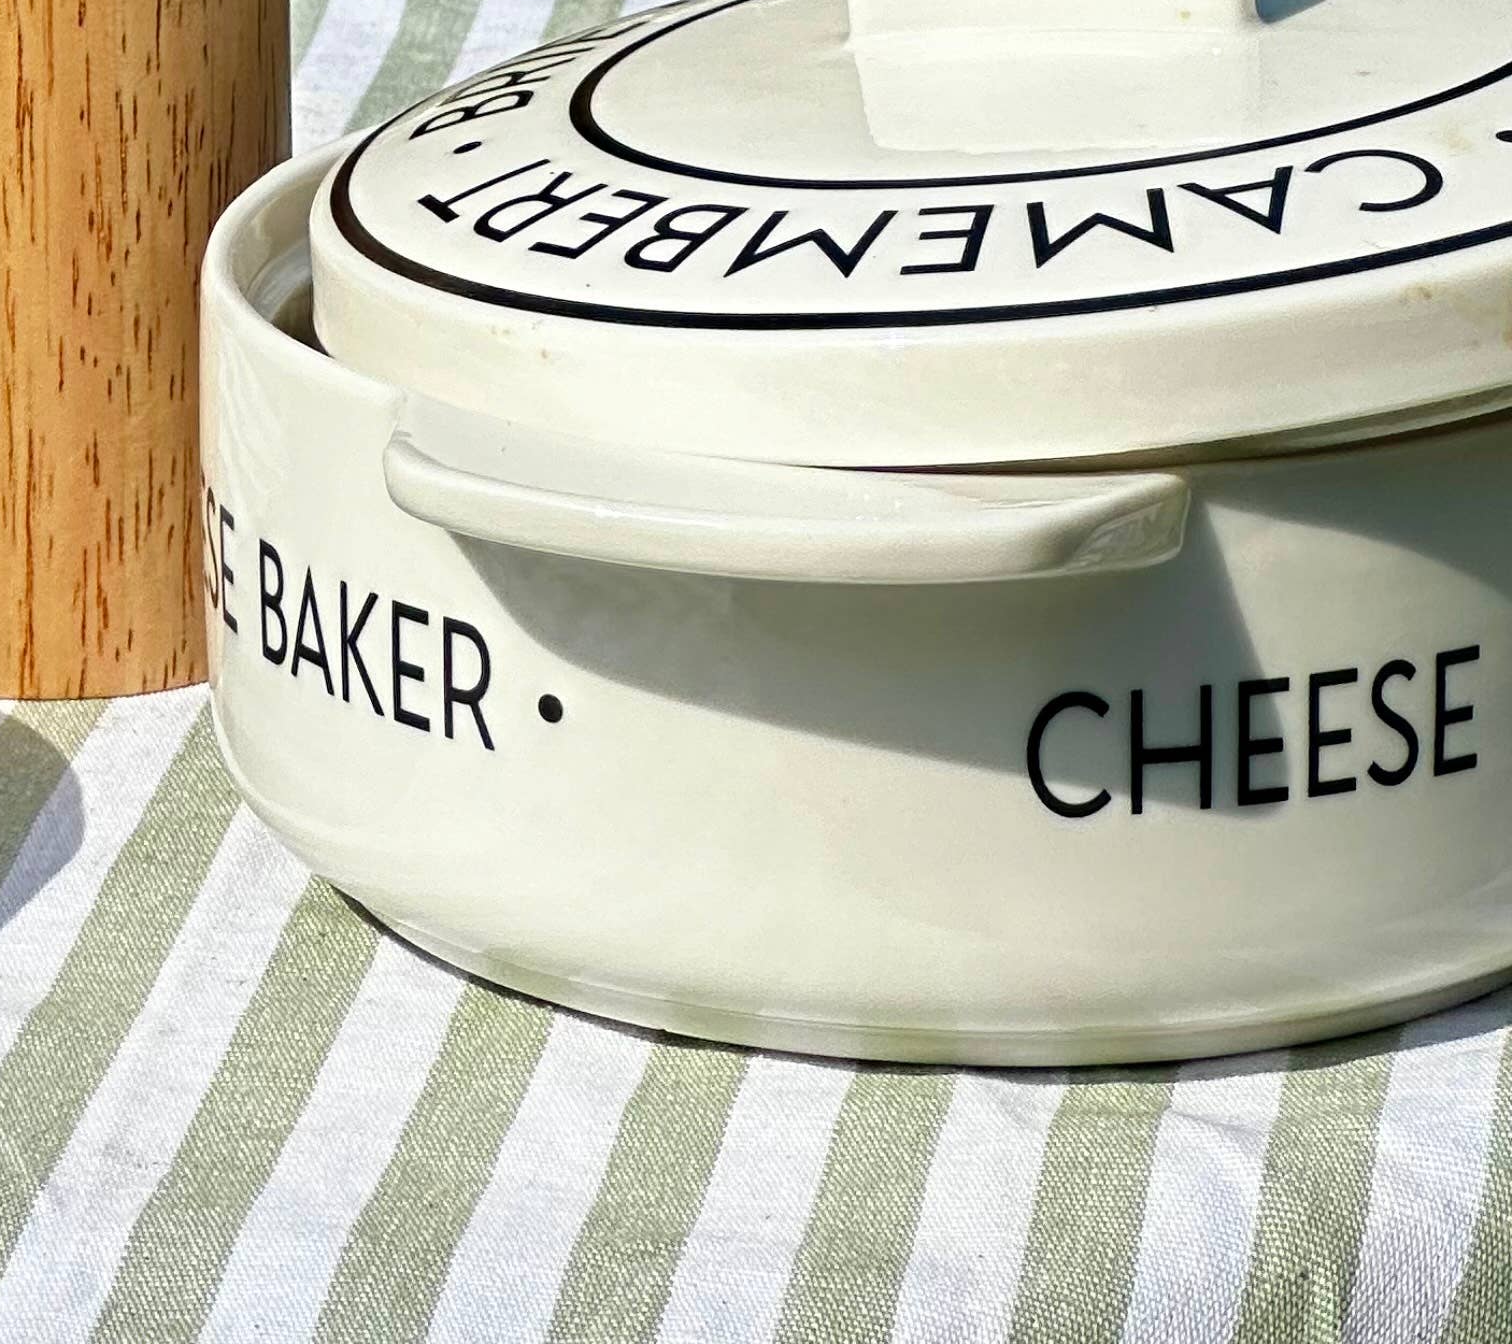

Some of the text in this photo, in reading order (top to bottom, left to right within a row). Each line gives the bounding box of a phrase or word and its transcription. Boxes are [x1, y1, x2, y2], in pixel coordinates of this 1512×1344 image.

[417, 149, 1443, 278] CAMEMBERT
[201, 470, 495, 751] SE BAKER
[1027, 645, 1480, 820] CHEESE
